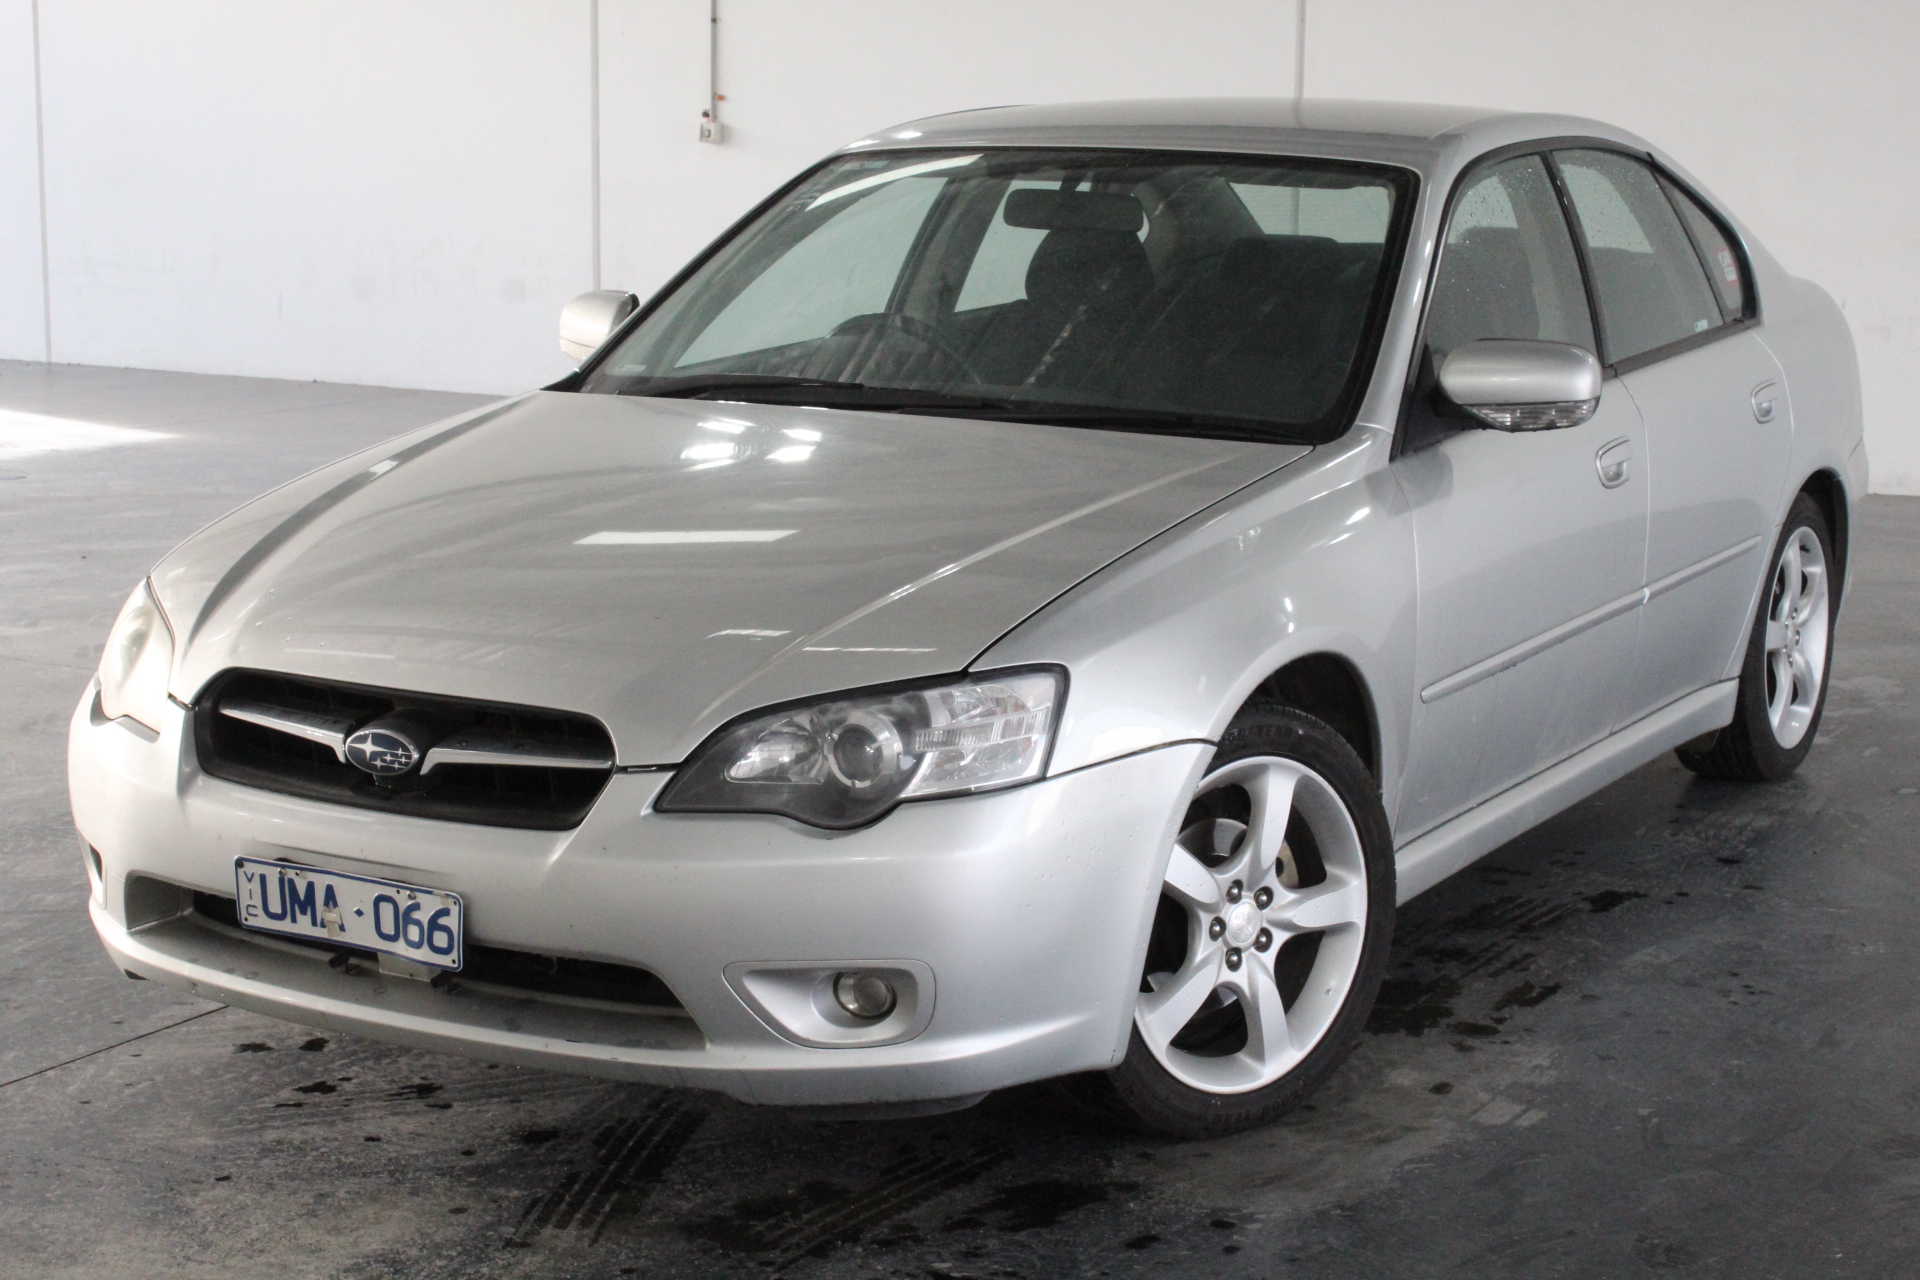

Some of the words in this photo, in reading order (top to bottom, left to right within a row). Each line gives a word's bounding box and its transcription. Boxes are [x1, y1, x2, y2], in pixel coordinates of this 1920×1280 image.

[243, 870, 259, 917] VIC
[259, 873, 346, 932] UMA
[373, 893, 455, 956] 066
